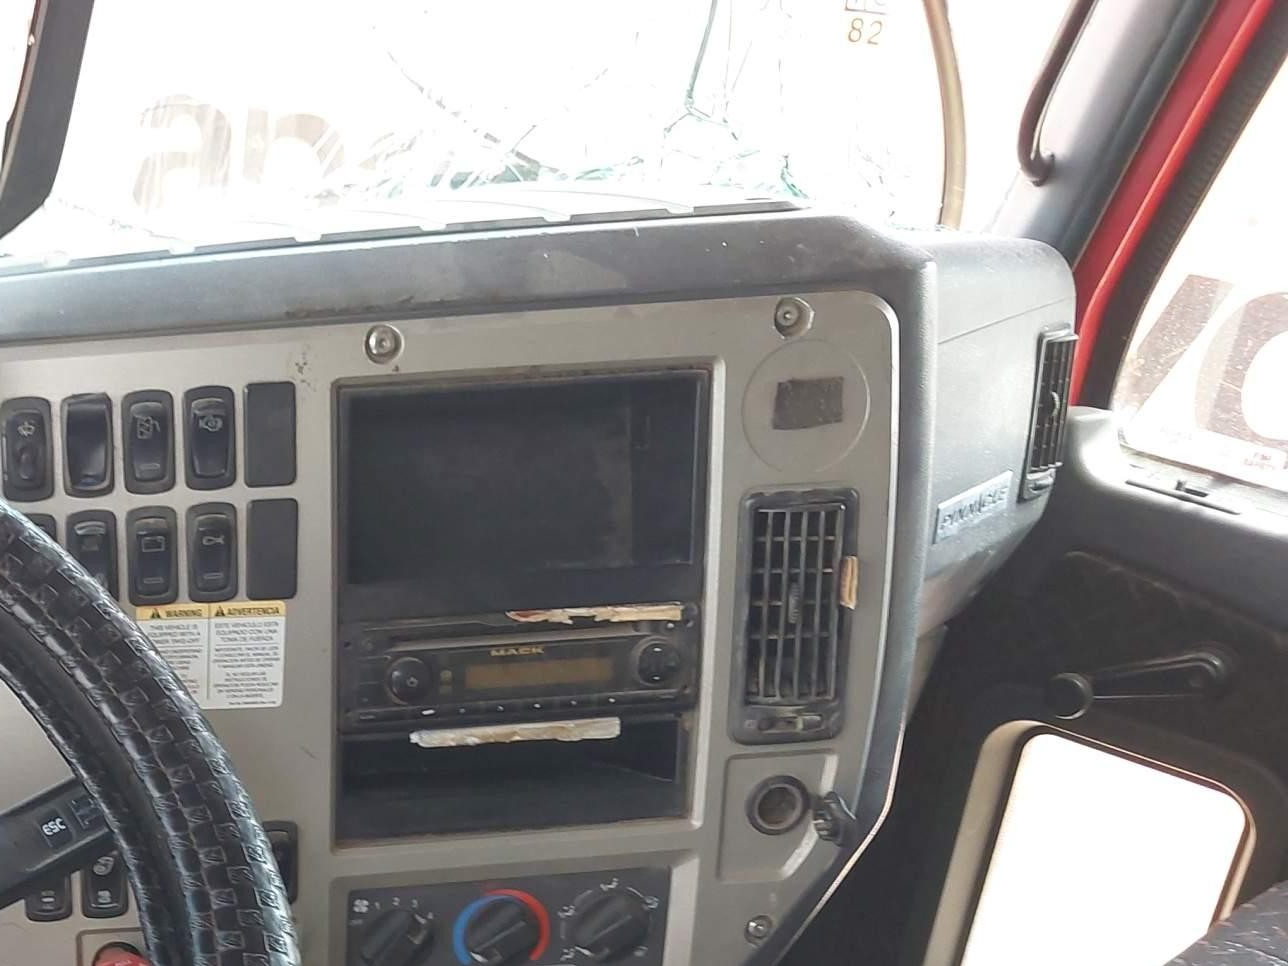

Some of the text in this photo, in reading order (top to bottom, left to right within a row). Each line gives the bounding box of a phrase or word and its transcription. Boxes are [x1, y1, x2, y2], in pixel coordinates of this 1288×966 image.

[847, 18, 883, 45] 82
[165, 608, 202, 618] WARNING
[227, 606, 280, 616] ADVERTENCIA
[489, 647, 545, 657] MACK
[41, 817, 67, 836] ESC
